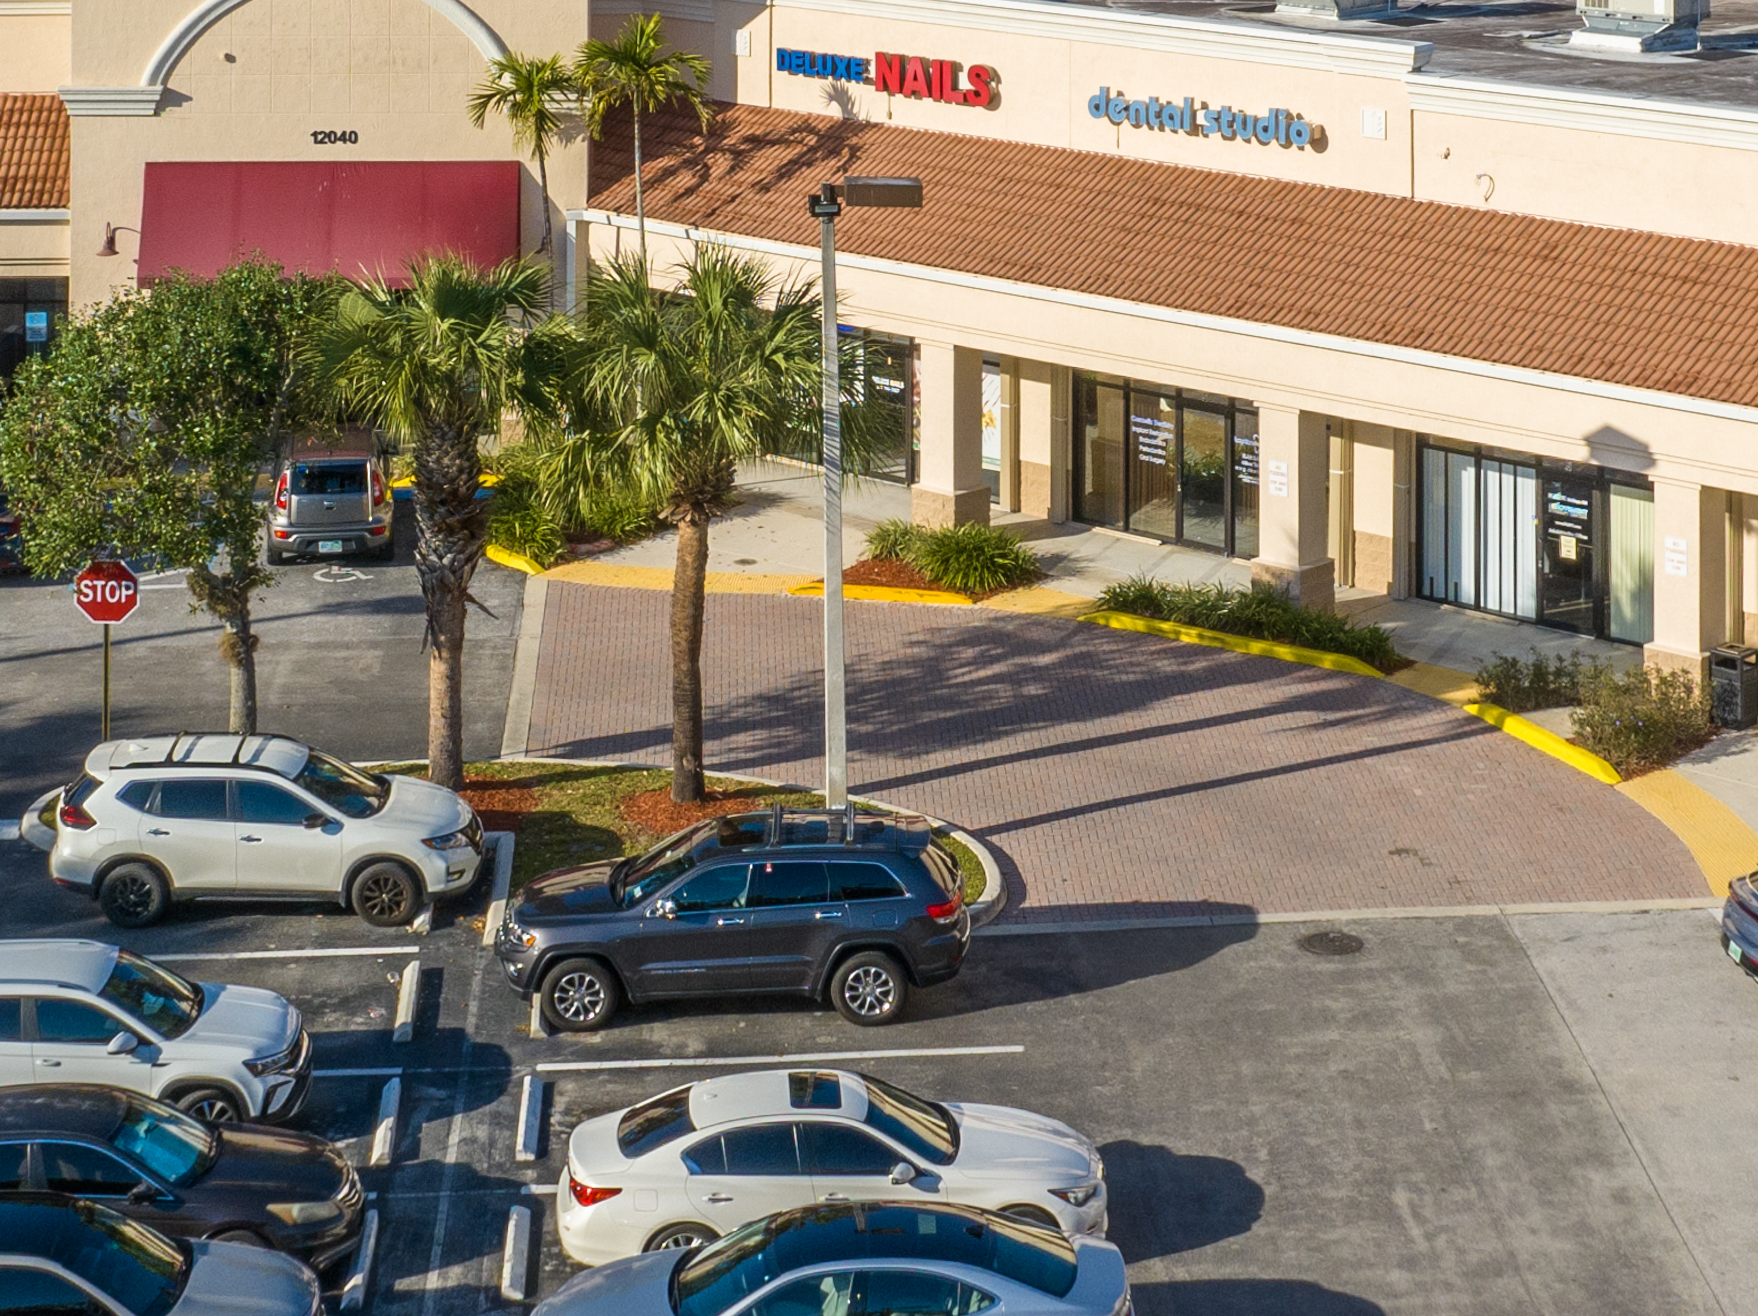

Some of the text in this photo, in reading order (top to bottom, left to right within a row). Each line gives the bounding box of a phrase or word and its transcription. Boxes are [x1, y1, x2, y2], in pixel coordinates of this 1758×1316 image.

[776, 47, 991, 108] DELUXE NAILS
[309, 130, 359, 145] 12040
[1087, 86, 1311, 147] dental studio
[79, 579, 135, 603] STOP
